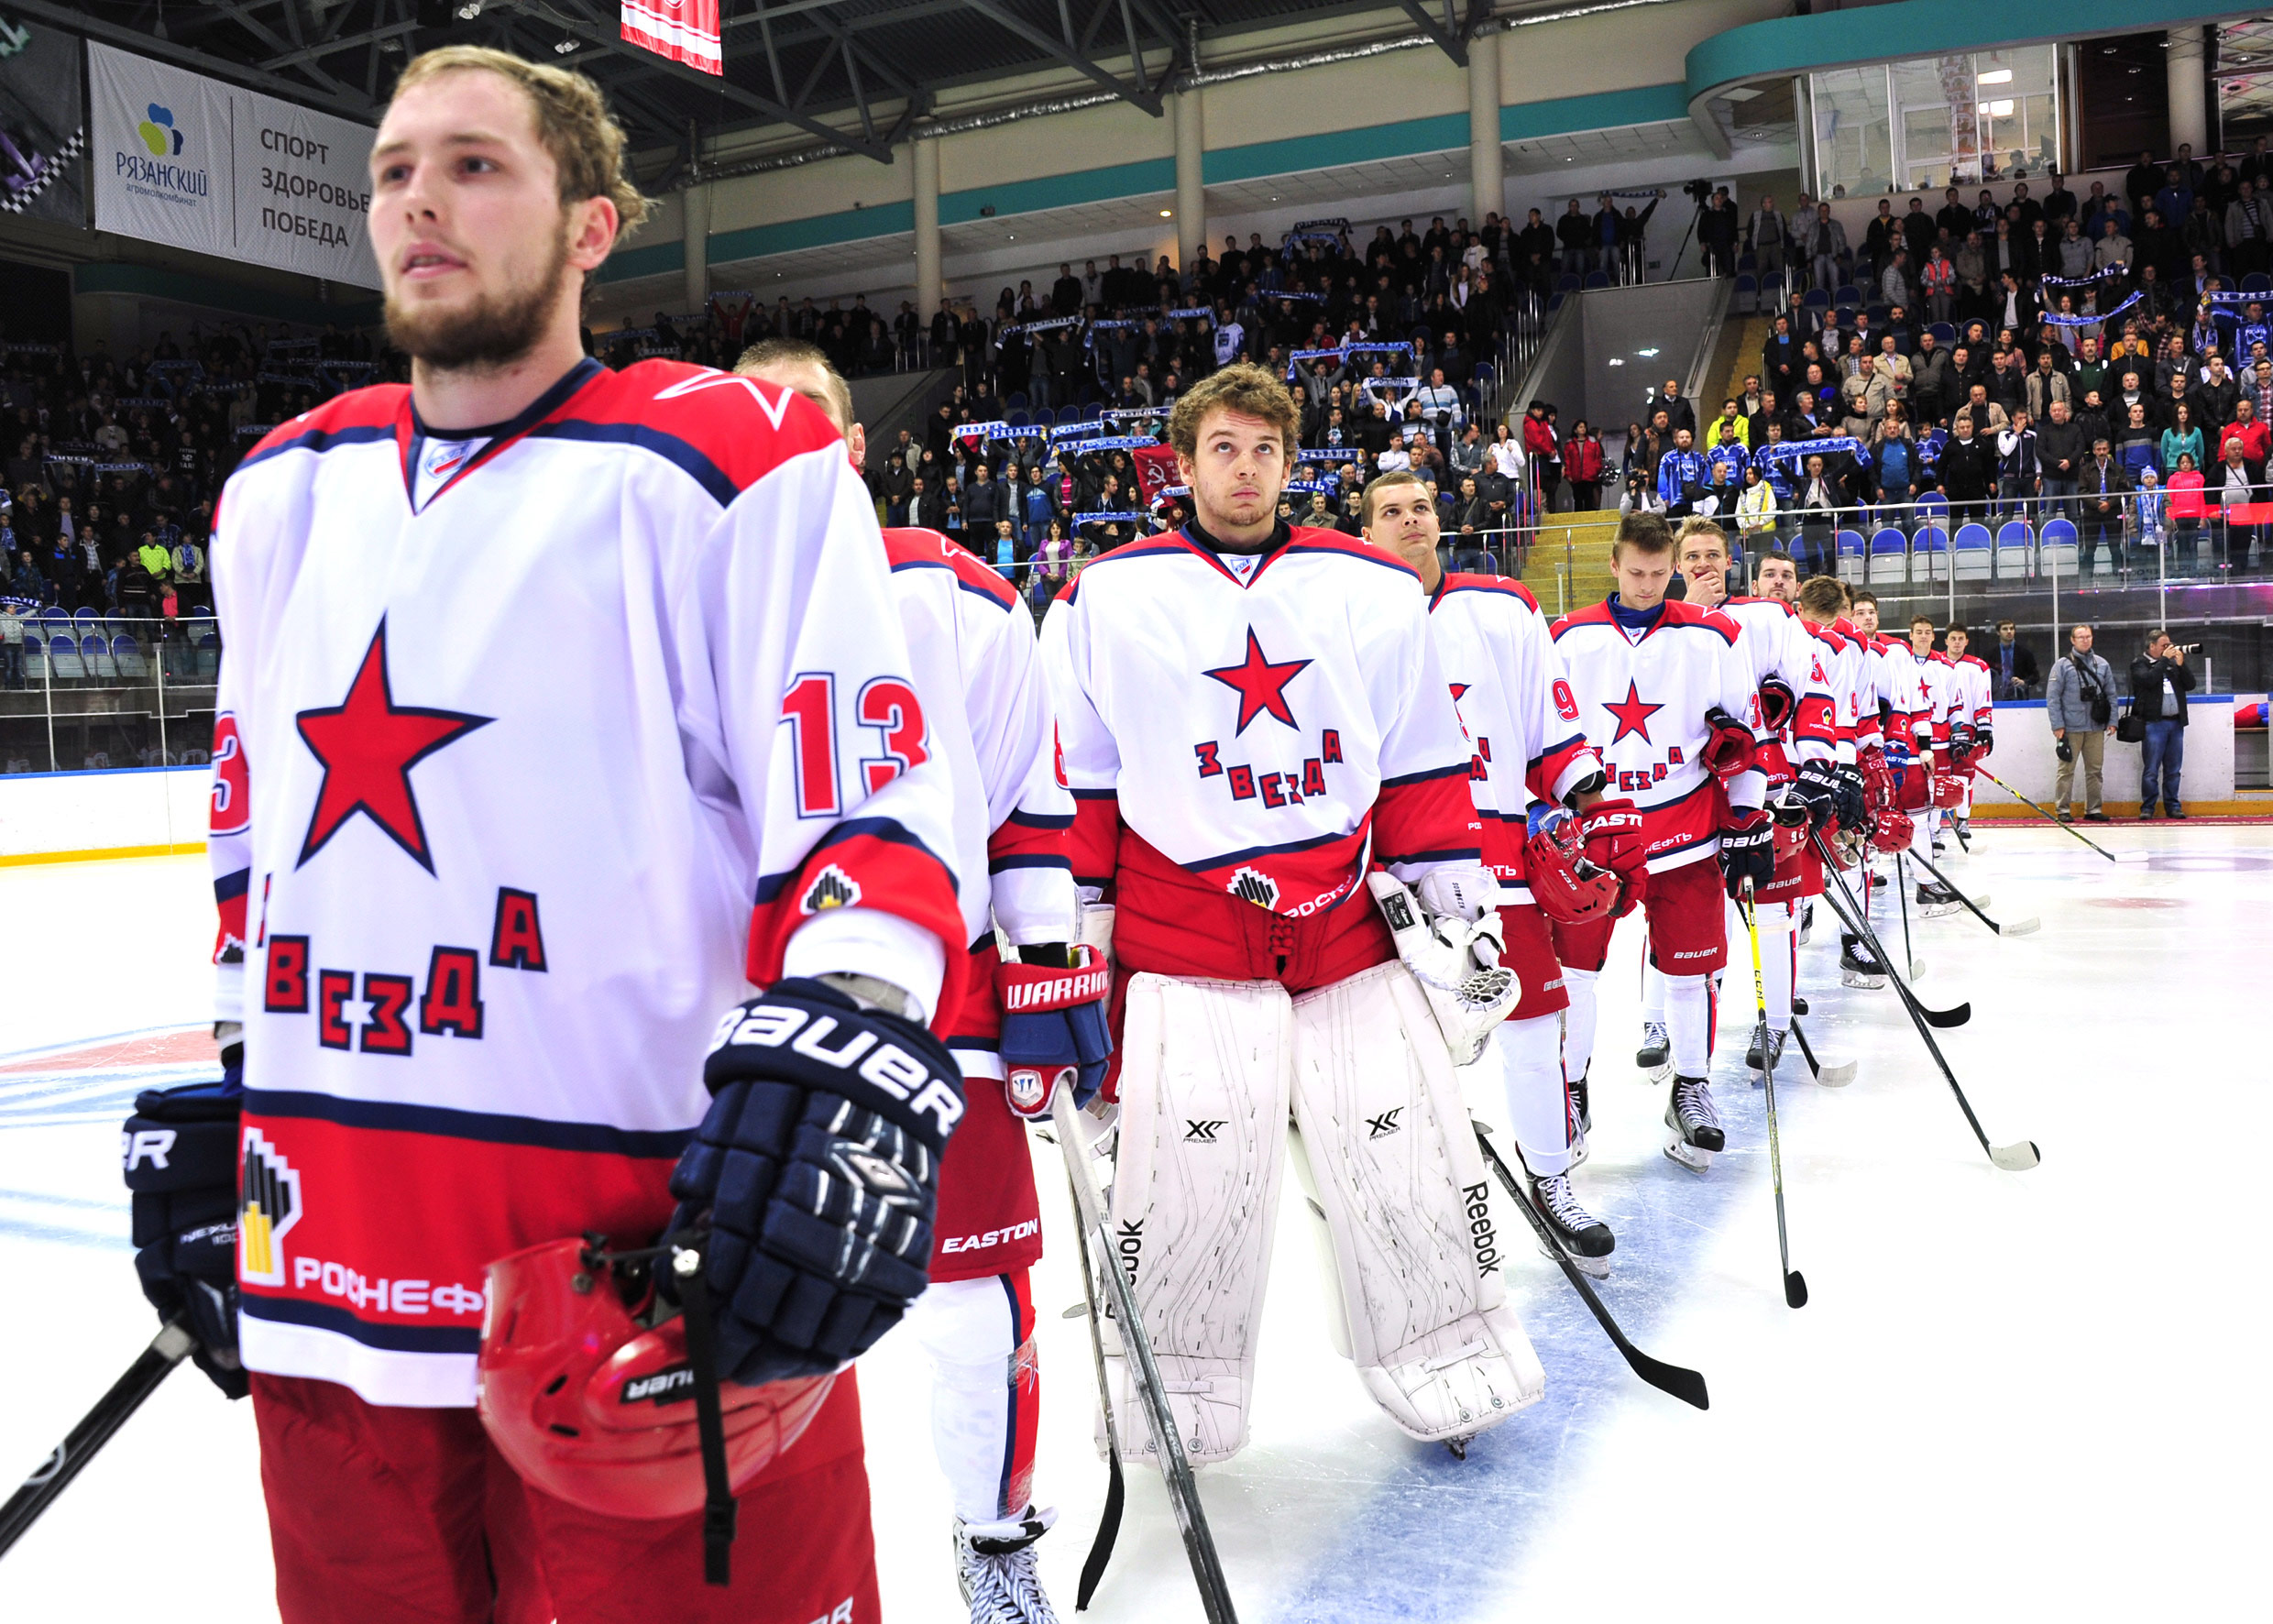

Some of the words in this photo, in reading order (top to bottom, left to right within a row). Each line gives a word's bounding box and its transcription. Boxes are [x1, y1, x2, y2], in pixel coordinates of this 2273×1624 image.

[260, 128, 329, 165] СПОРТ
[116, 151, 208, 197] РЯЗАНСКИЙ
[261, 167, 370, 214] ЗДОРОВЬЕ
[126, 183, 197, 207] агромолкомбинат
[262, 207, 349, 248] ПОБЕДА
[993, 427, 1038, 437] РЯЗАНЬ
[1300, 450, 1351, 460] РЯЗАНЬ
[1290, 481, 1324, 490] АНЬ
[1552, 677, 1580, 722] 9
[779, 672, 931, 819] 13
[1798, 770, 1840, 789] BAUE
[1582, 813, 1643, 836] EAST
[257, 873, 547, 1057] ВЕЗДА
[1674, 947, 1718, 960] BAUER
[1754, 970, 1763, 1000] CCM
[1369, 1126, 1400, 1141] PREMIER
[941, 1218, 1038, 1254] EASTON
[1462, 1180, 1497, 1279] Reebok
[295, 1256, 488, 1315] РОСНЕФ
[627, 1368, 695, 1399] UER
